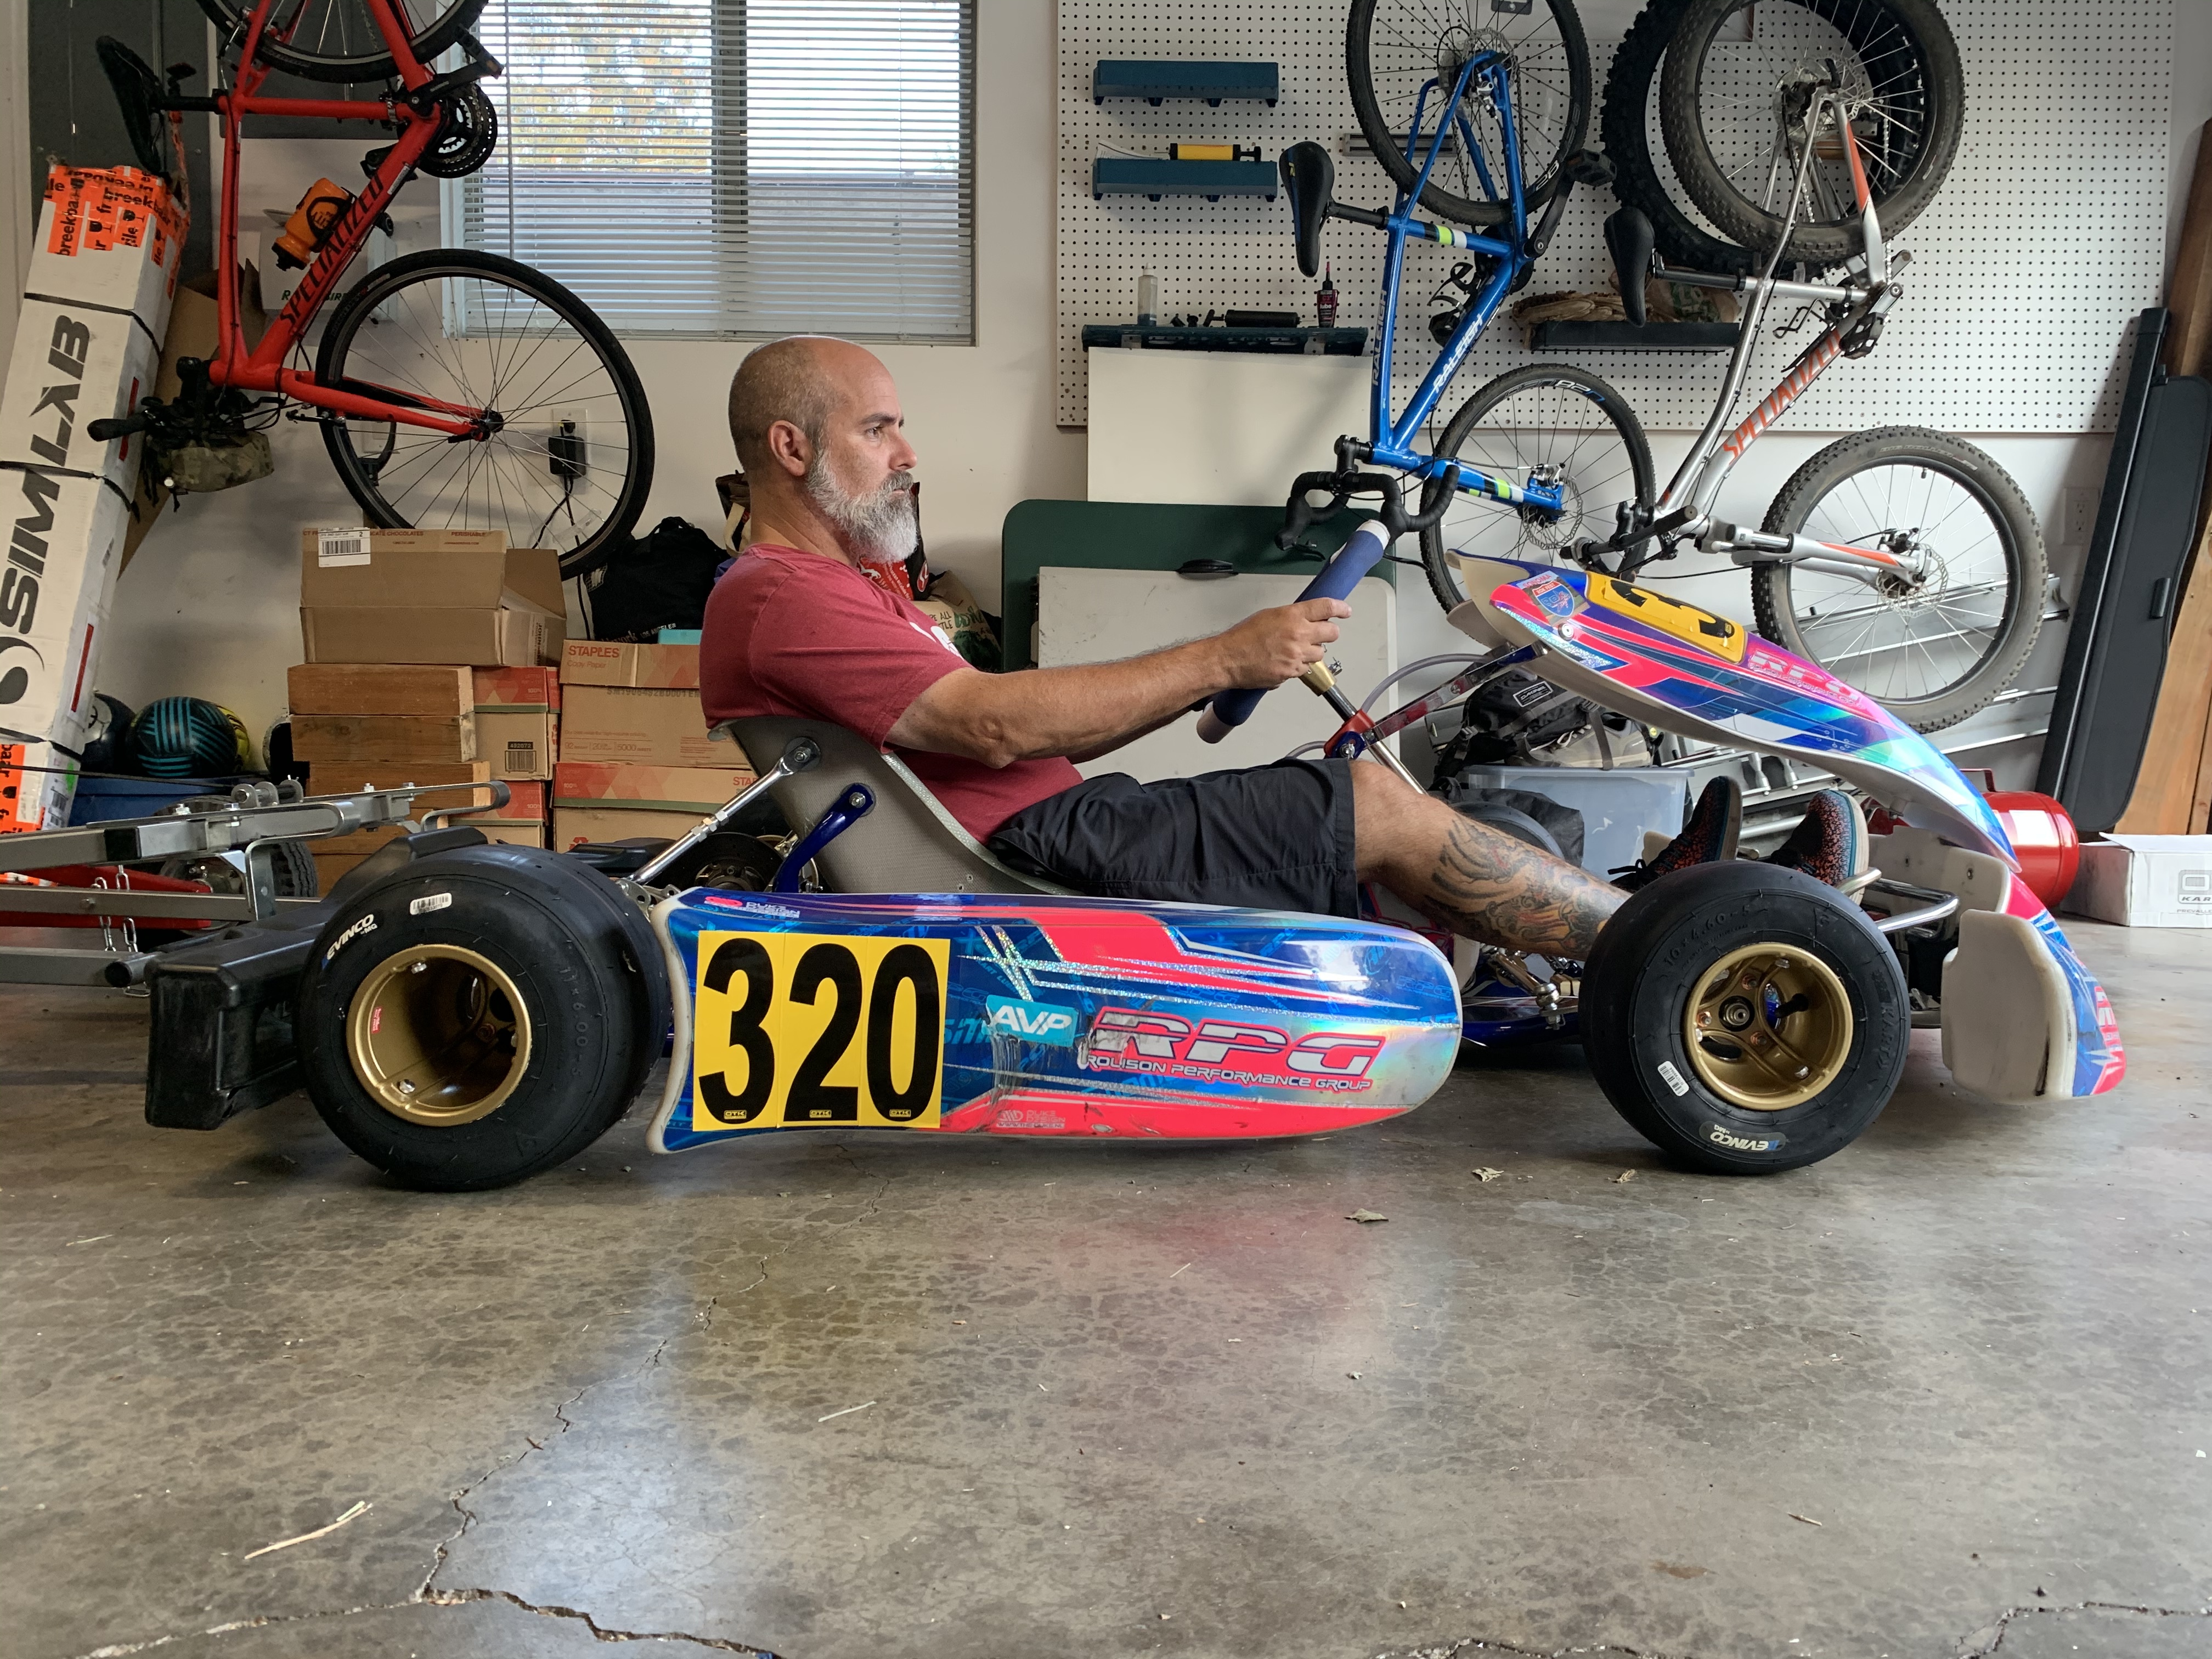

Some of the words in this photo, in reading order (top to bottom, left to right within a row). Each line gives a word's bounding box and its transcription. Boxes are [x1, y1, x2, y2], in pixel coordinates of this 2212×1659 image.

[280, 173, 384, 326] SPECIALIZED
[1433, 313, 1483, 394] RALEIGH
[1722, 329, 1842, 466] SPECIALIZED
[940, 611, 952, 620] ALL
[568, 645, 619, 658] STAPLES
[326, 913, 375, 960] EVINCO
[698, 938, 943, 1125] 320
[992, 1005, 1073, 1035] AVP
[1093, 1011, 1383, 1076] RPG
[1087, 1056, 1166, 1074] ROLISON
[1171, 1063, 1311, 1087] PERFORMANCE
[1314, 1078, 1373, 1092] GROUP
[1709, 1132, 1769, 1151] EVINCO
